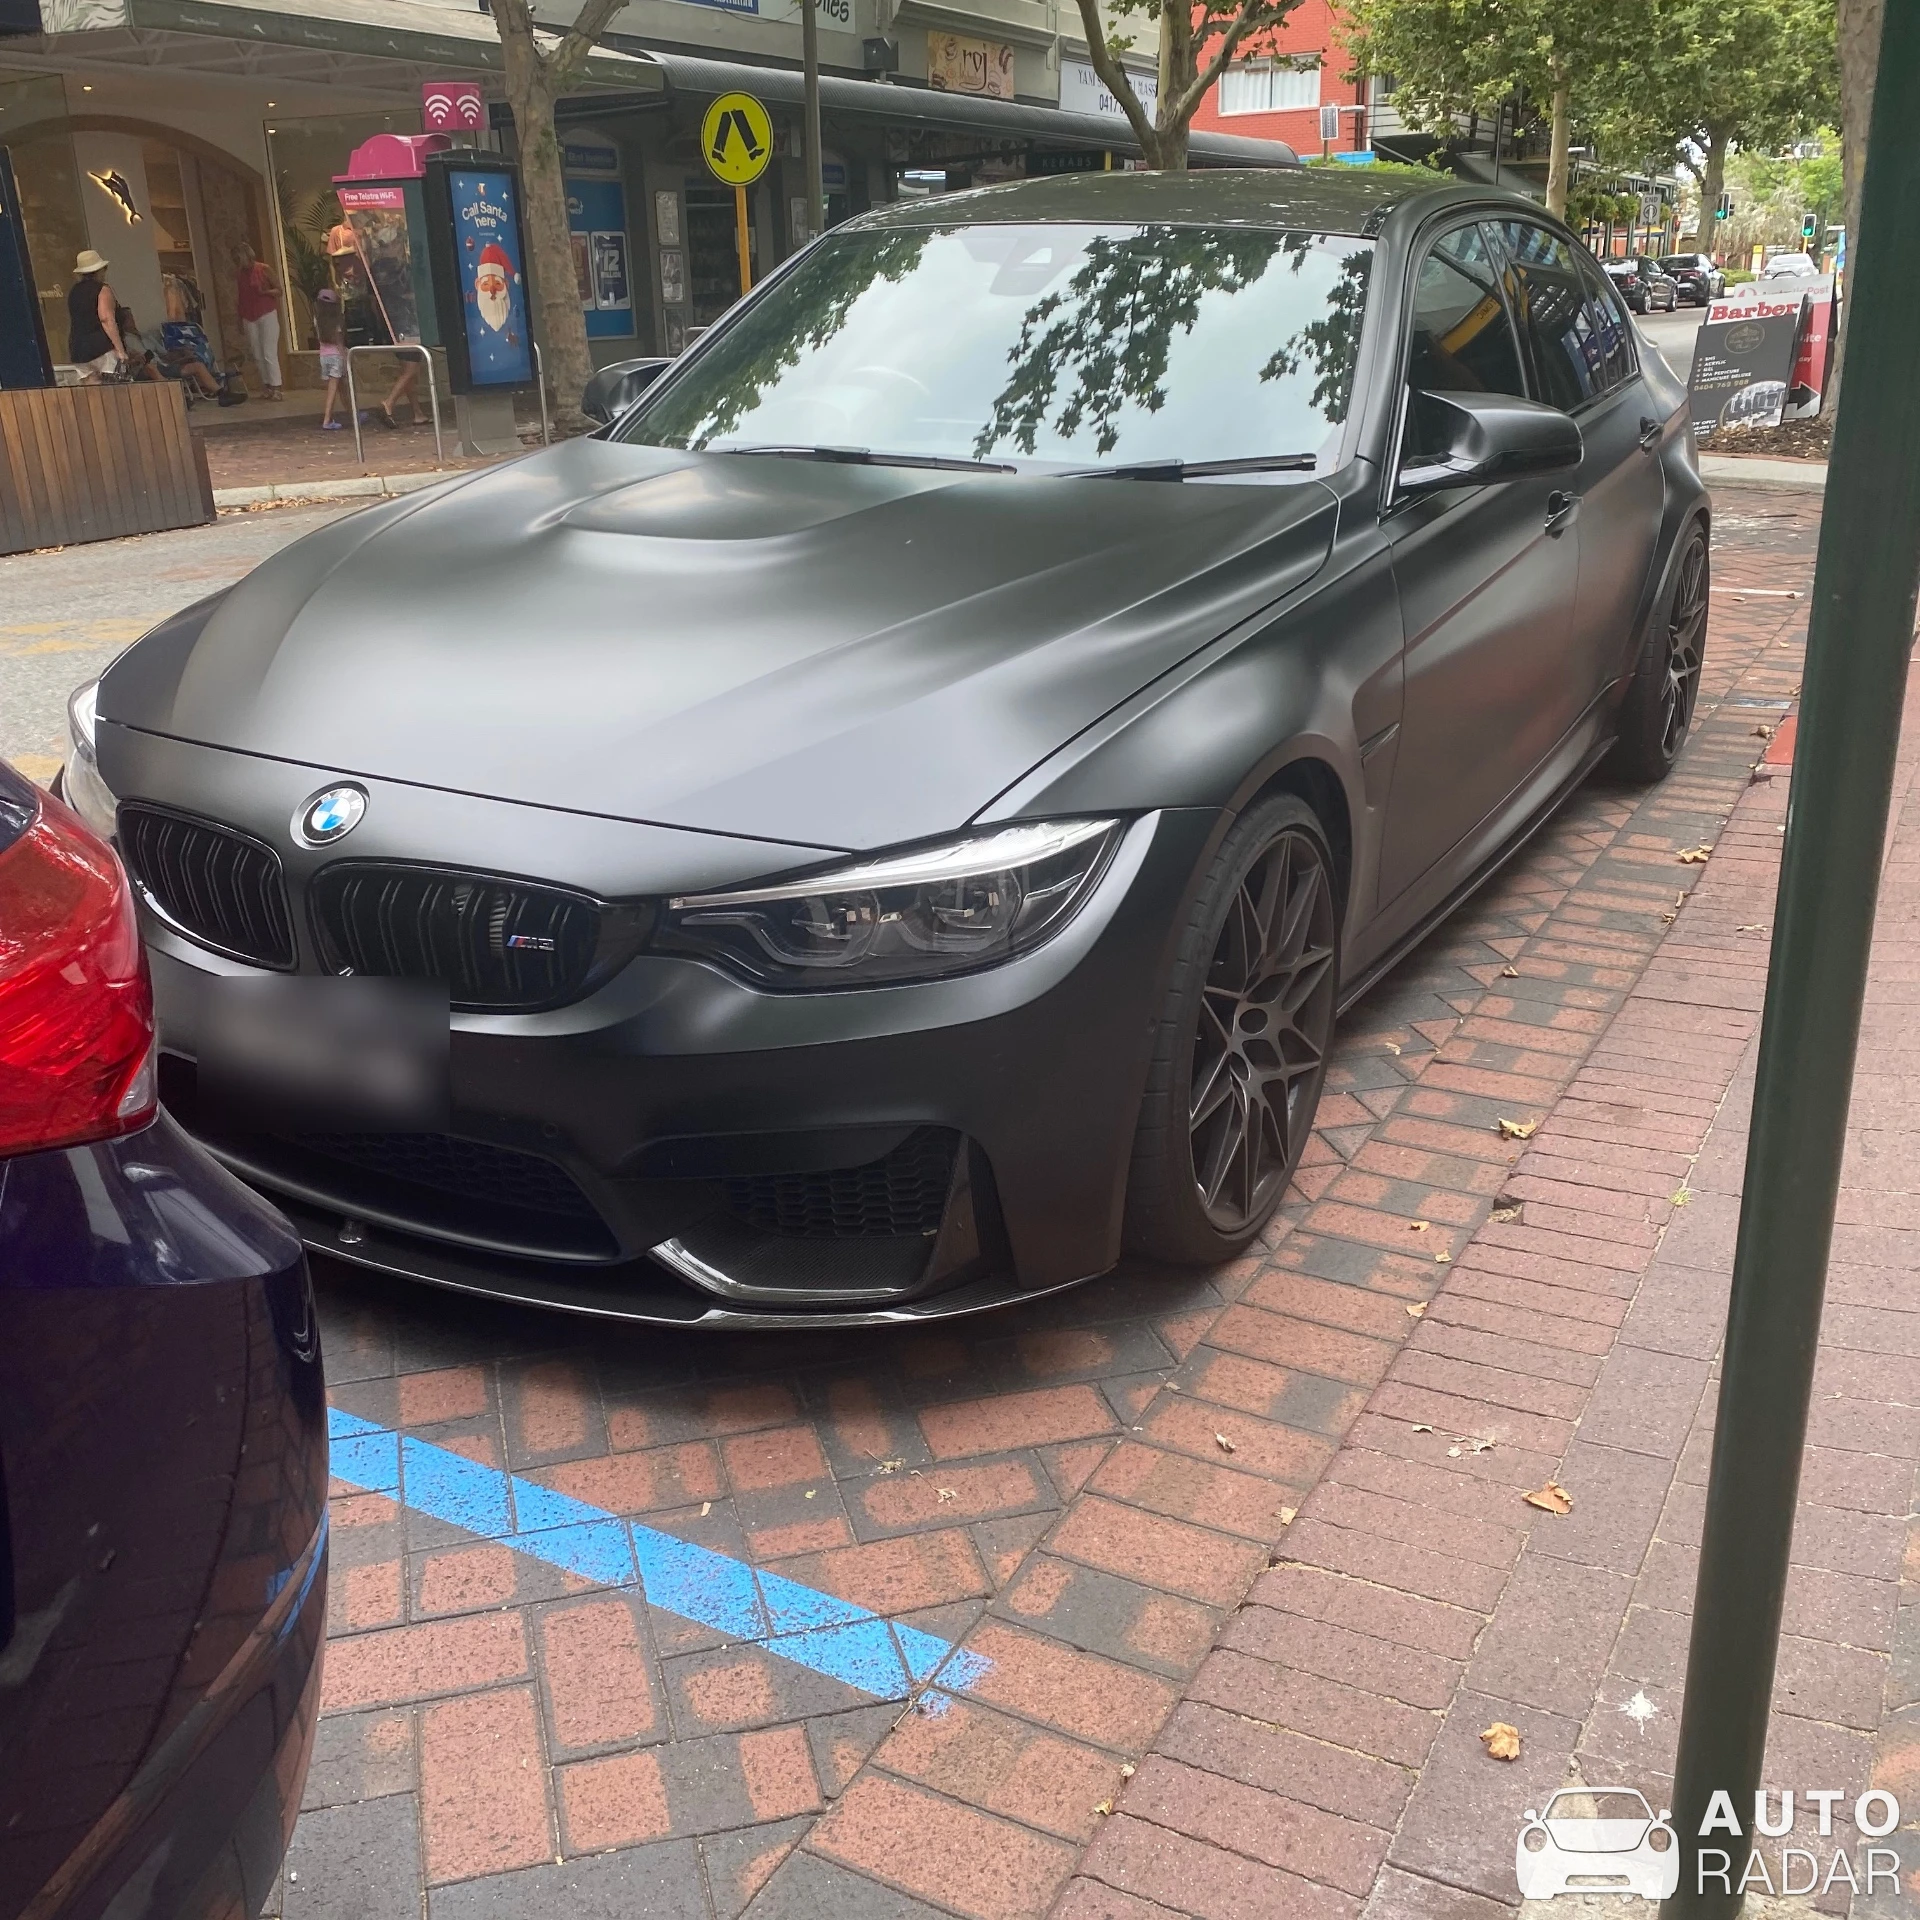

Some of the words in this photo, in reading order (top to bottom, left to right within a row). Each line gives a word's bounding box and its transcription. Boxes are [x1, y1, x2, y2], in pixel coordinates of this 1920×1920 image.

[358, 192, 379, 200] Telstra
[462, 202, 479, 220] Call
[480, 201, 508, 222] Santa
[474, 216, 497, 228] here
[1807, 285, 1830, 295] Post
[1710, 302, 1799, 320] Barber
[1713, 368, 1740, 376] PEDICURE
[1694, 383, 1713, 391] 0404
